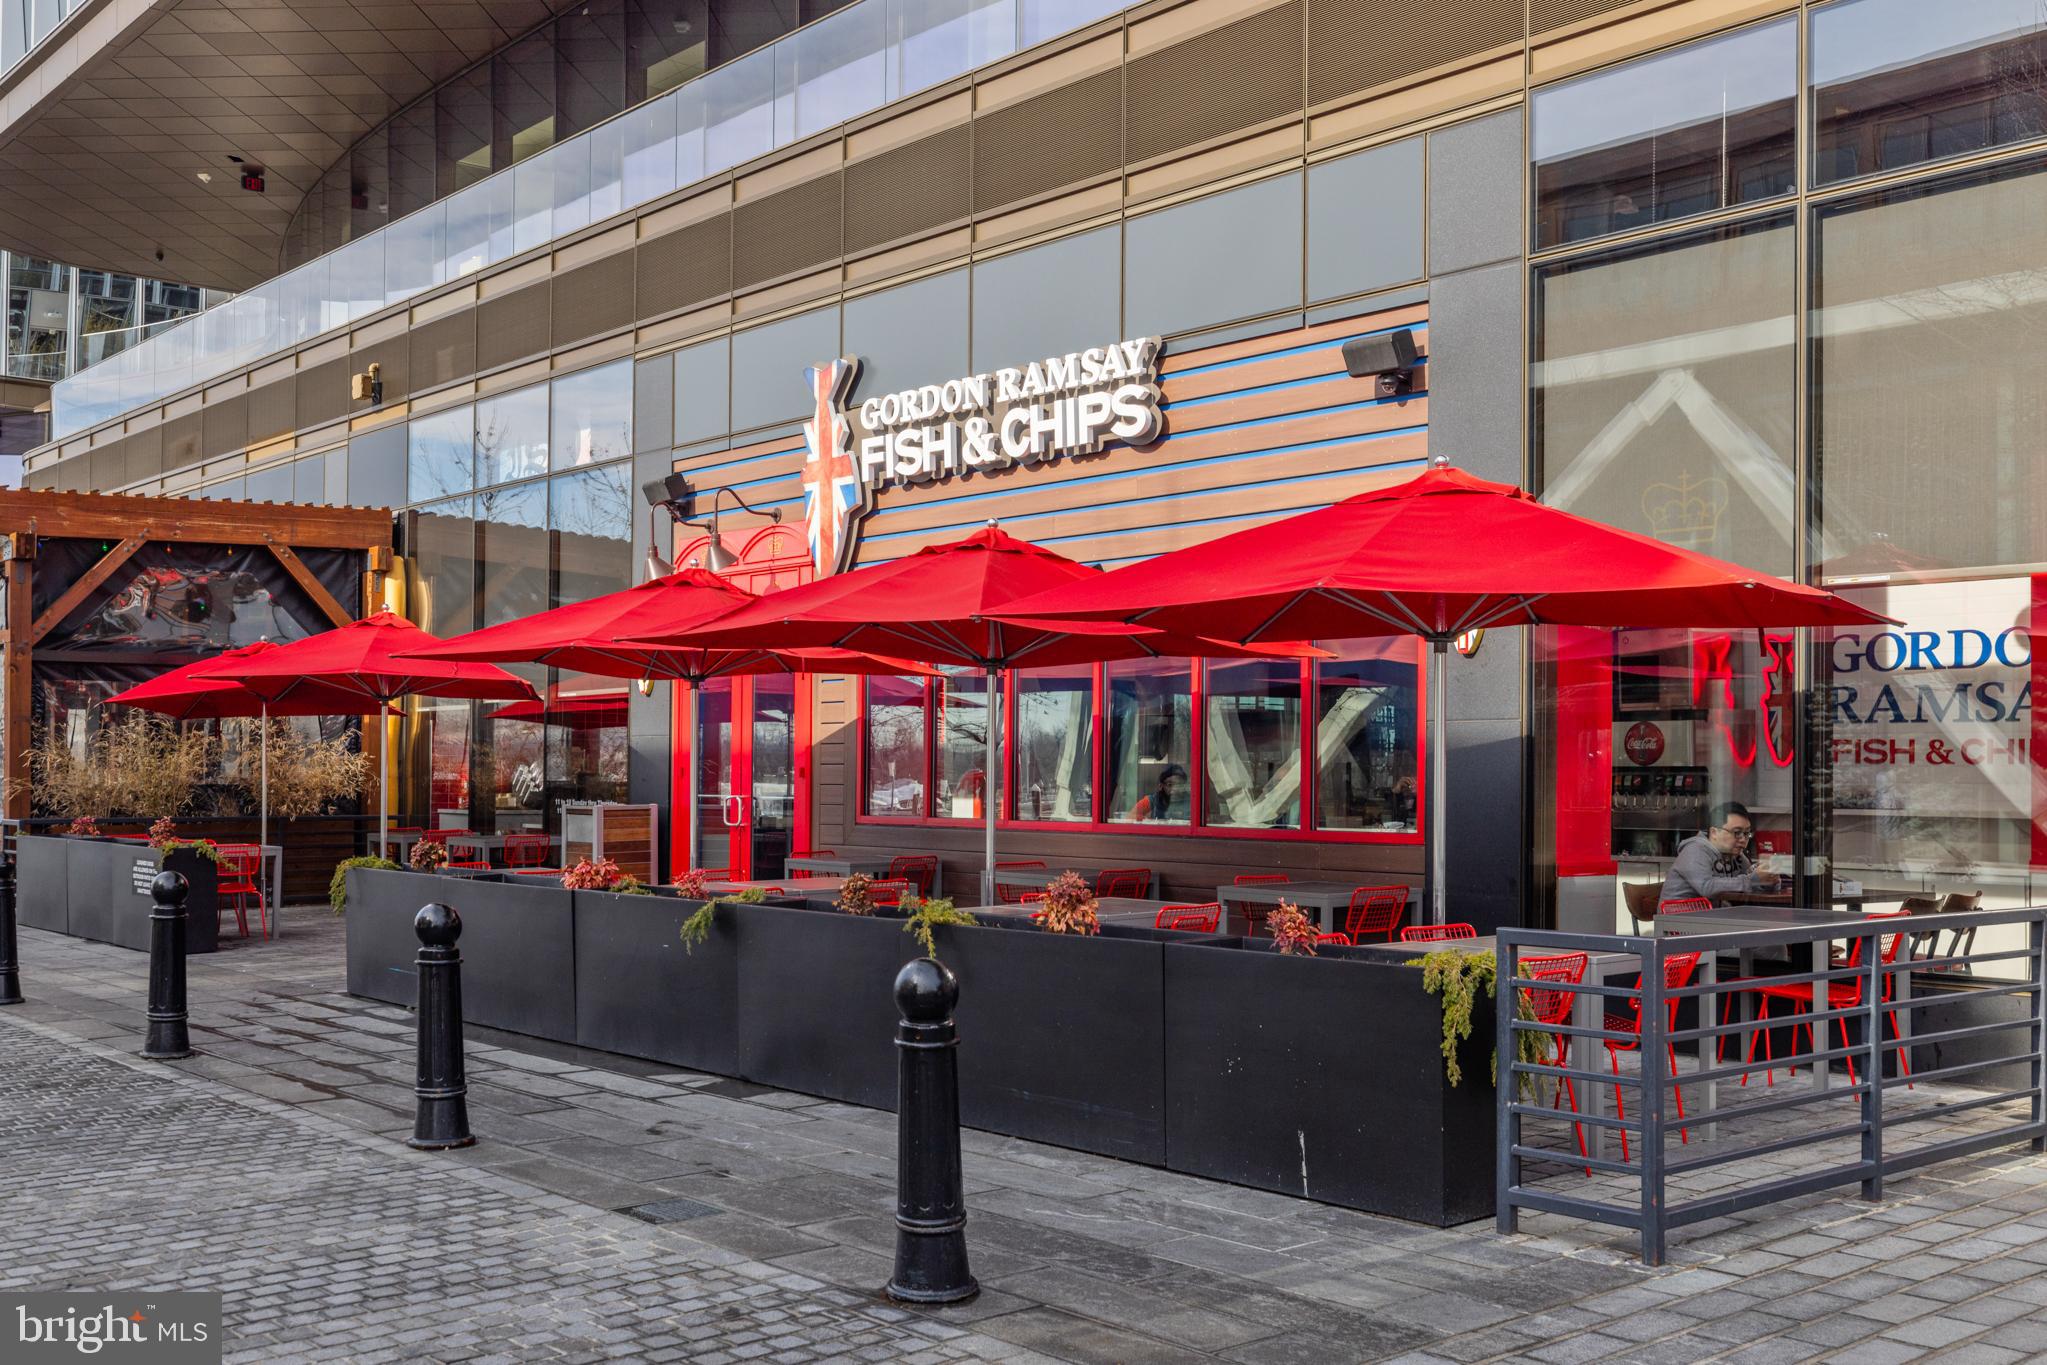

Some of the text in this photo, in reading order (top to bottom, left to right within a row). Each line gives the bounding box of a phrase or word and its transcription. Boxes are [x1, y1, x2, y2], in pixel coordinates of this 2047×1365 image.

[860, 337, 1152, 430] GORDON RAMSAY
[861, 384, 1153, 483] FISH & CHIPS
[1833, 626, 2032, 673] GORDO
[1832, 738, 2032, 765] FISH & CHI
